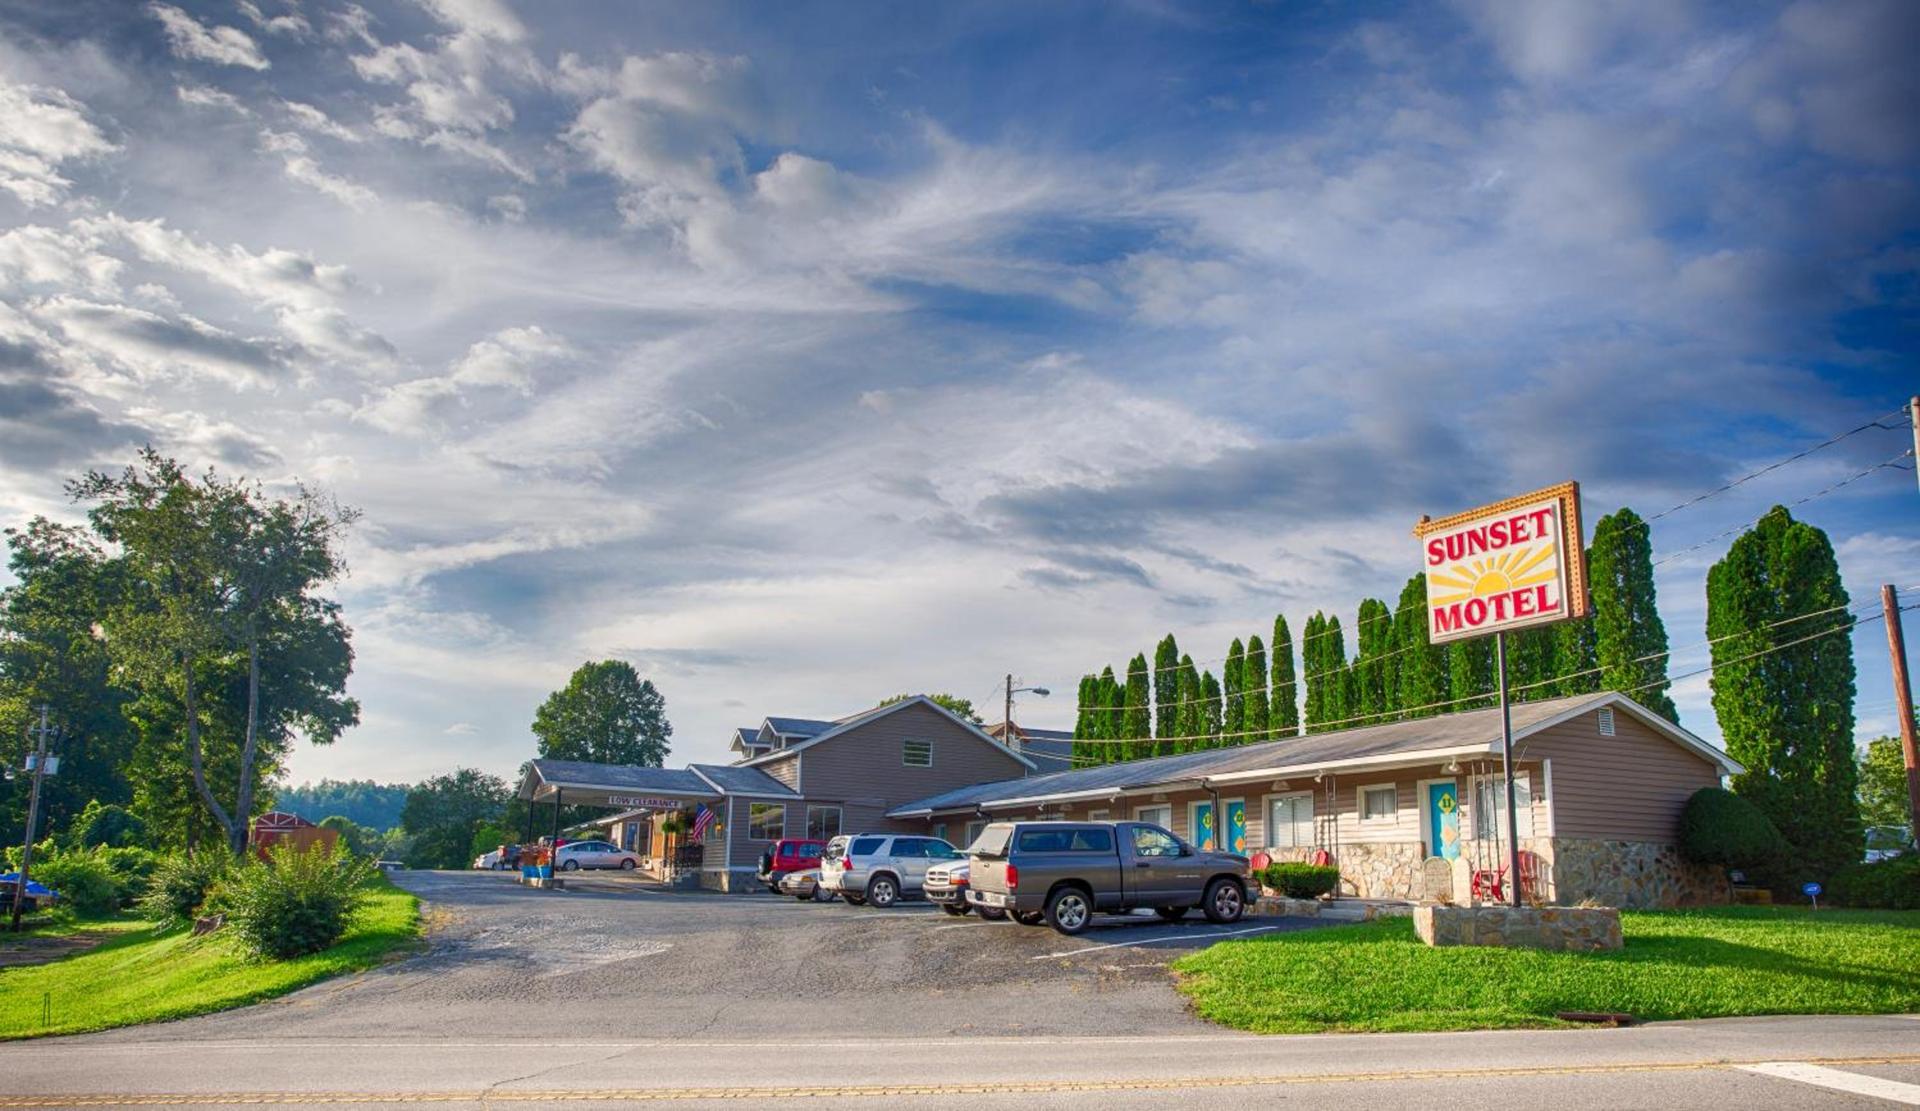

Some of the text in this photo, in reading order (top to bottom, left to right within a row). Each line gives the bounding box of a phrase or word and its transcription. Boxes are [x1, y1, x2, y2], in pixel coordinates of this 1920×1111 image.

[1427, 508, 1553, 566] SUNSET
[1433, 584, 1559, 634] MOTEL
[610, 795, 678, 807] LOW CLEARANCE
